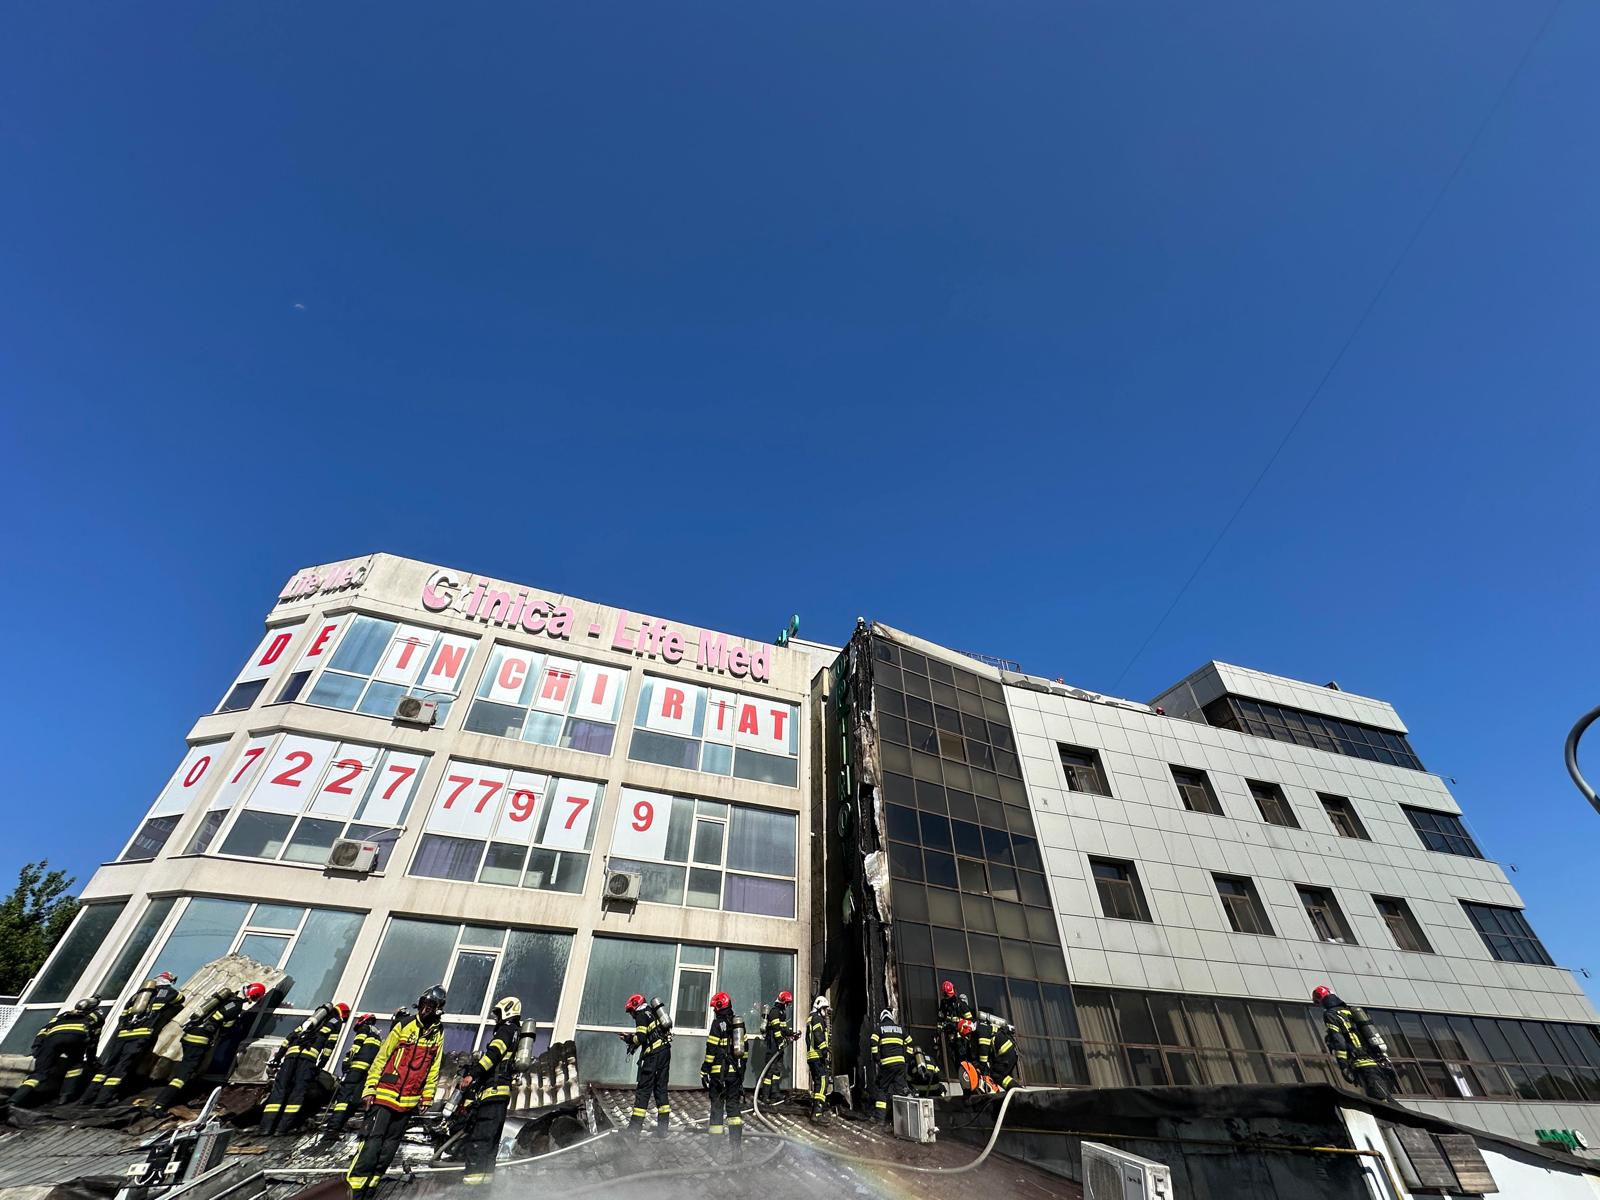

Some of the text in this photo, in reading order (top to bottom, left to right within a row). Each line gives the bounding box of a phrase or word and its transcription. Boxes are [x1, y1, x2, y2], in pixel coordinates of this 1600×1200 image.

[278, 571, 321, 602] Life
[258, 624, 337, 667] DE
[611, 609, 686, 664] Life
[696, 630, 771, 682] Med
